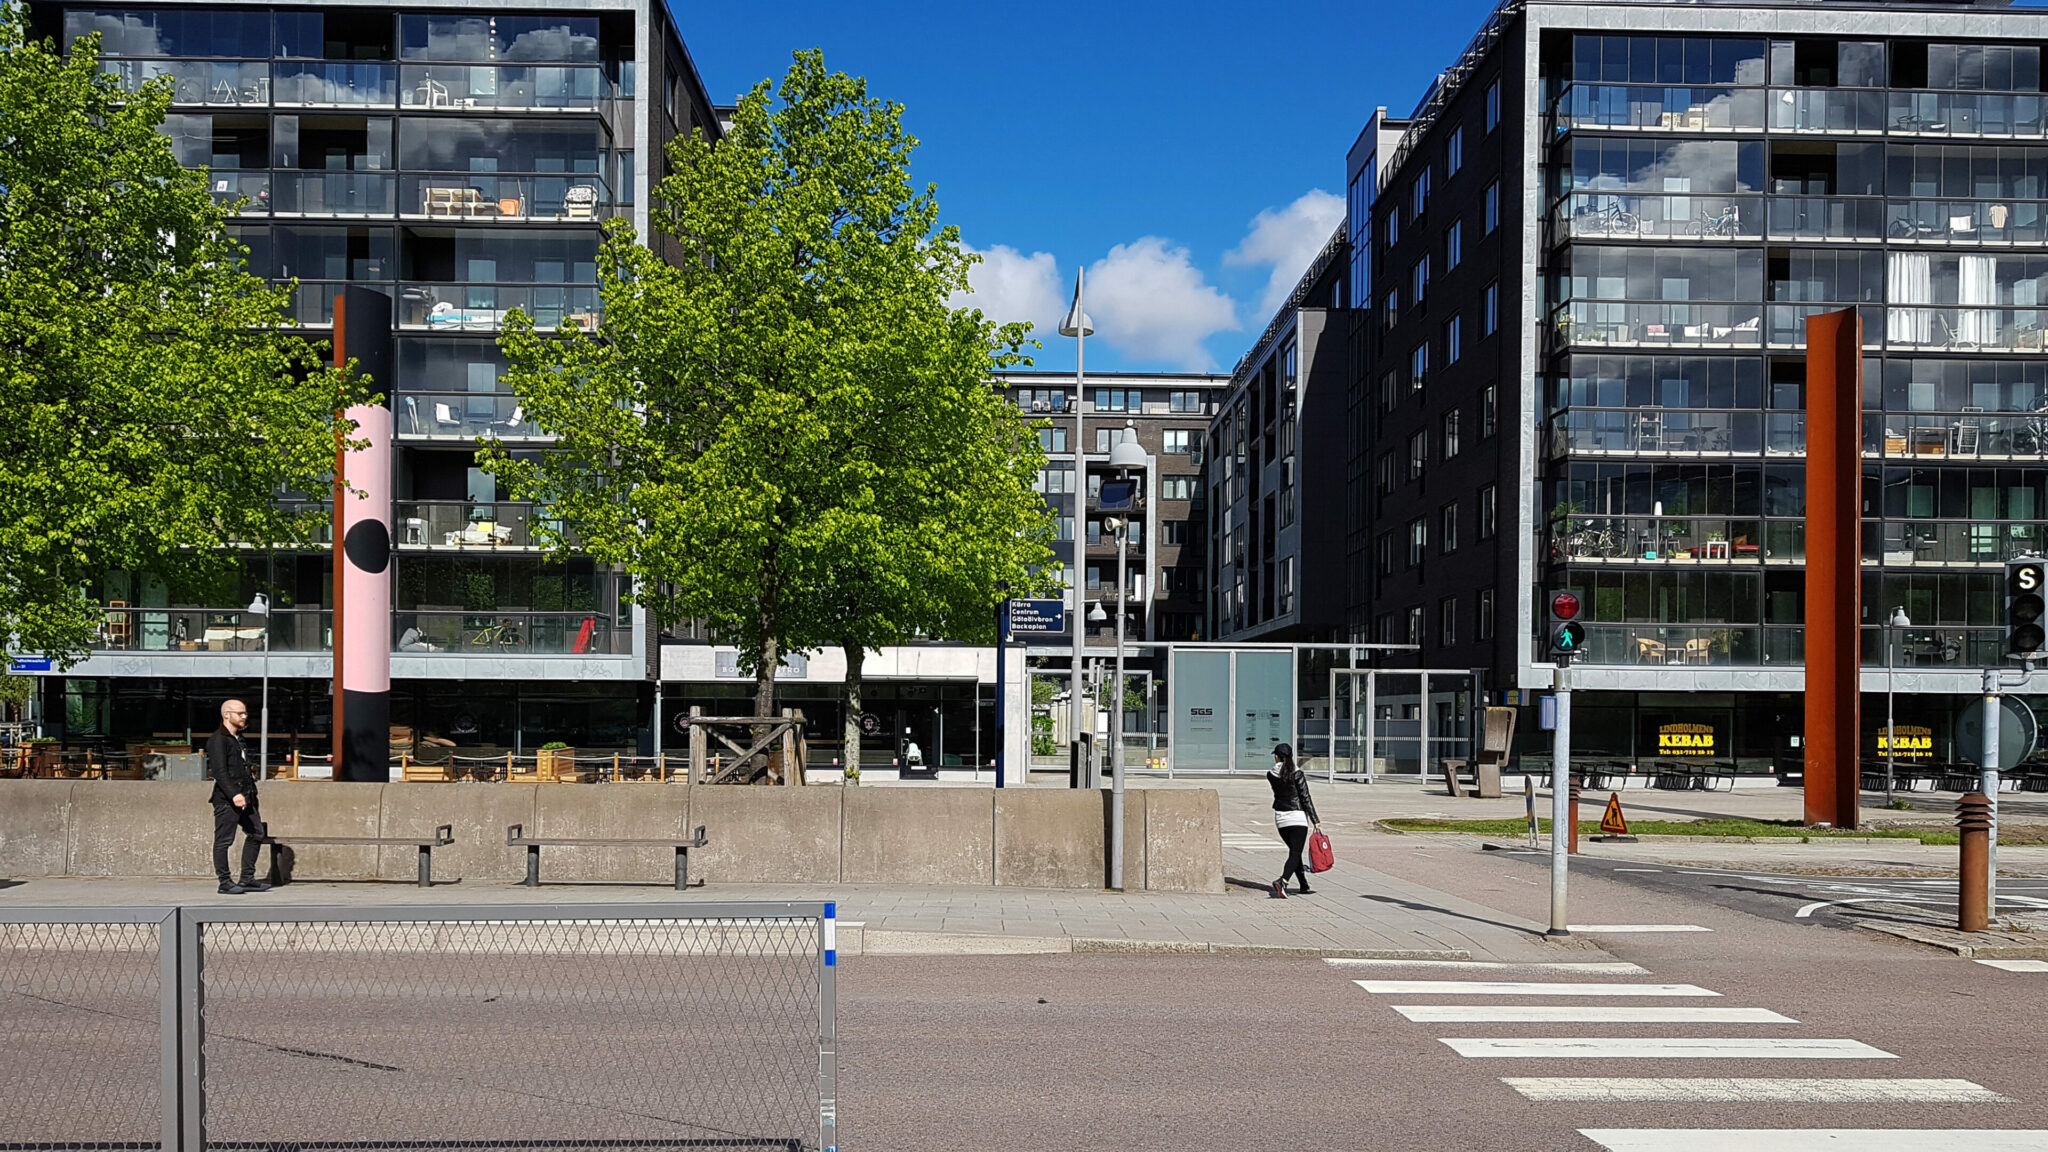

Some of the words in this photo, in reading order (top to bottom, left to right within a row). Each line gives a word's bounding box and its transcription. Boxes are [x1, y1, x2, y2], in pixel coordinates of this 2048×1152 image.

[2019, 567, 2036, 589] S
[1190, 708, 1213, 716] SGS
[1659, 734, 1714, 747] KEBAB
[1877, 736, 1932, 748] KEBAB
